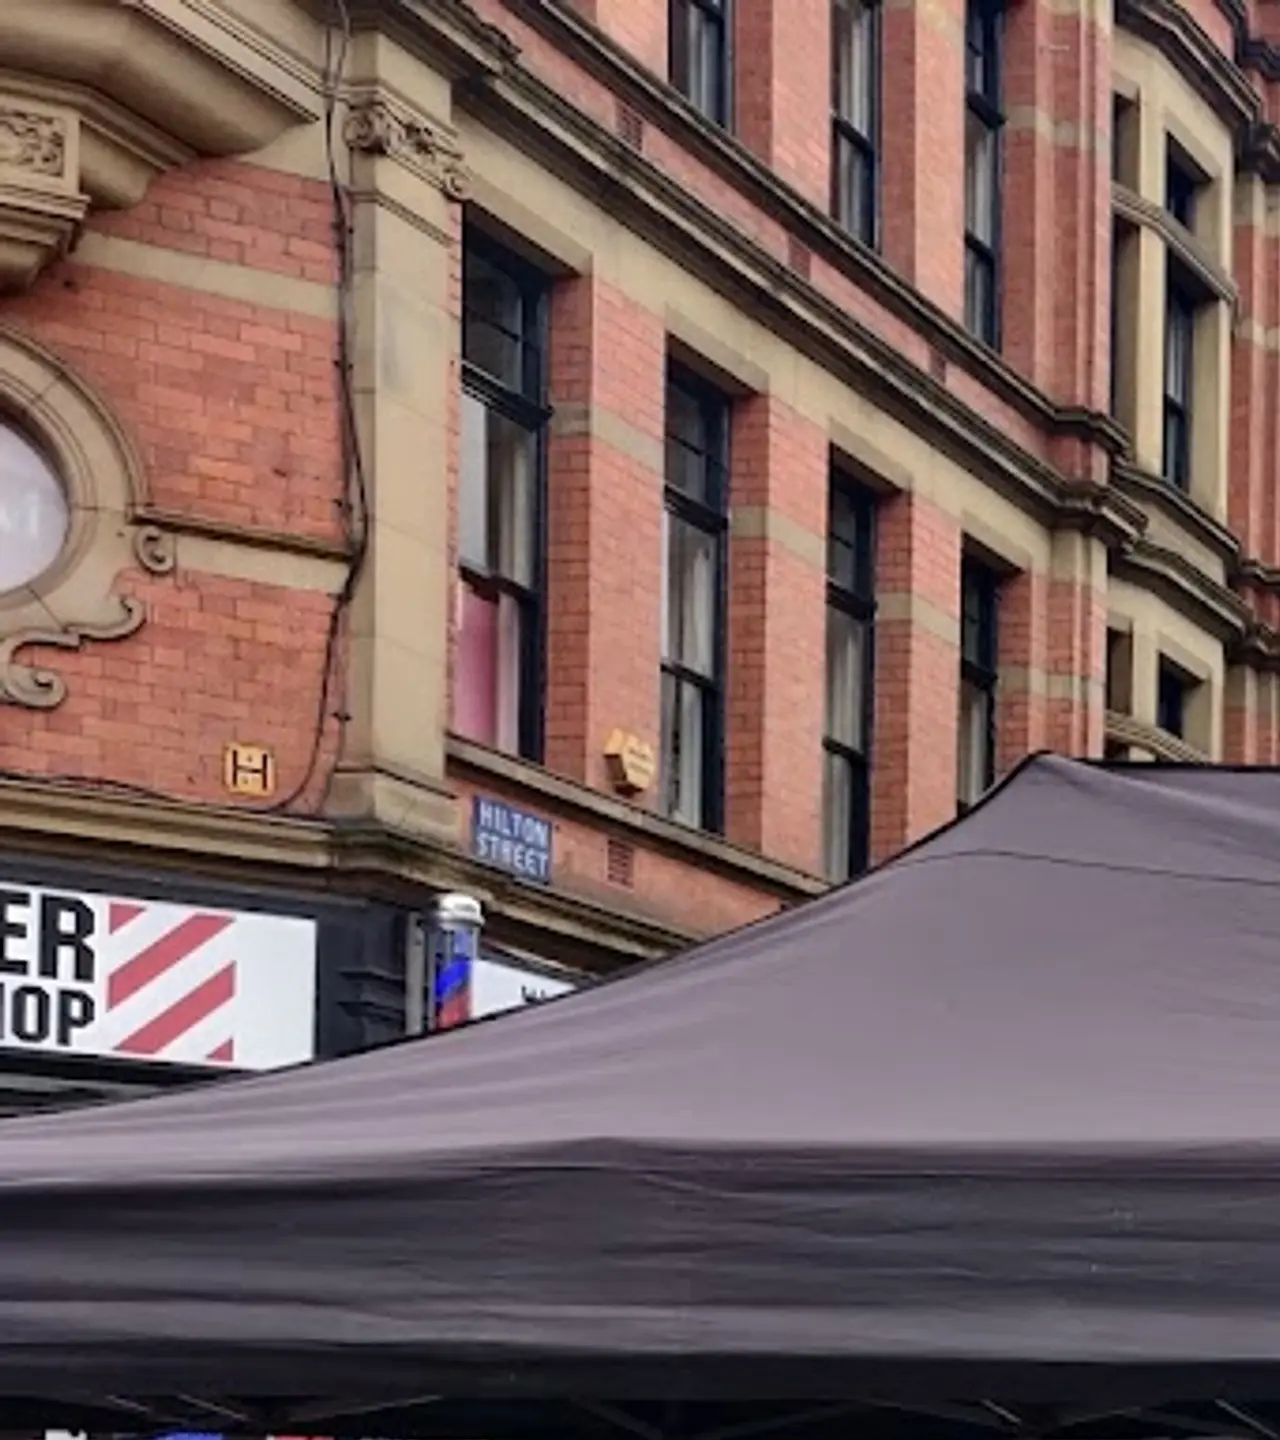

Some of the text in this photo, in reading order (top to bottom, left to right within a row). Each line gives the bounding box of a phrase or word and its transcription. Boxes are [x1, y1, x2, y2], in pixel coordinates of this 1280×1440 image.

[232, 749, 268, 792] H
[479, 800, 548, 849] HILTON
[476, 831, 548, 877] STREET
[0, 888, 95, 983] ER
[0, 981, 95, 1047] OP
